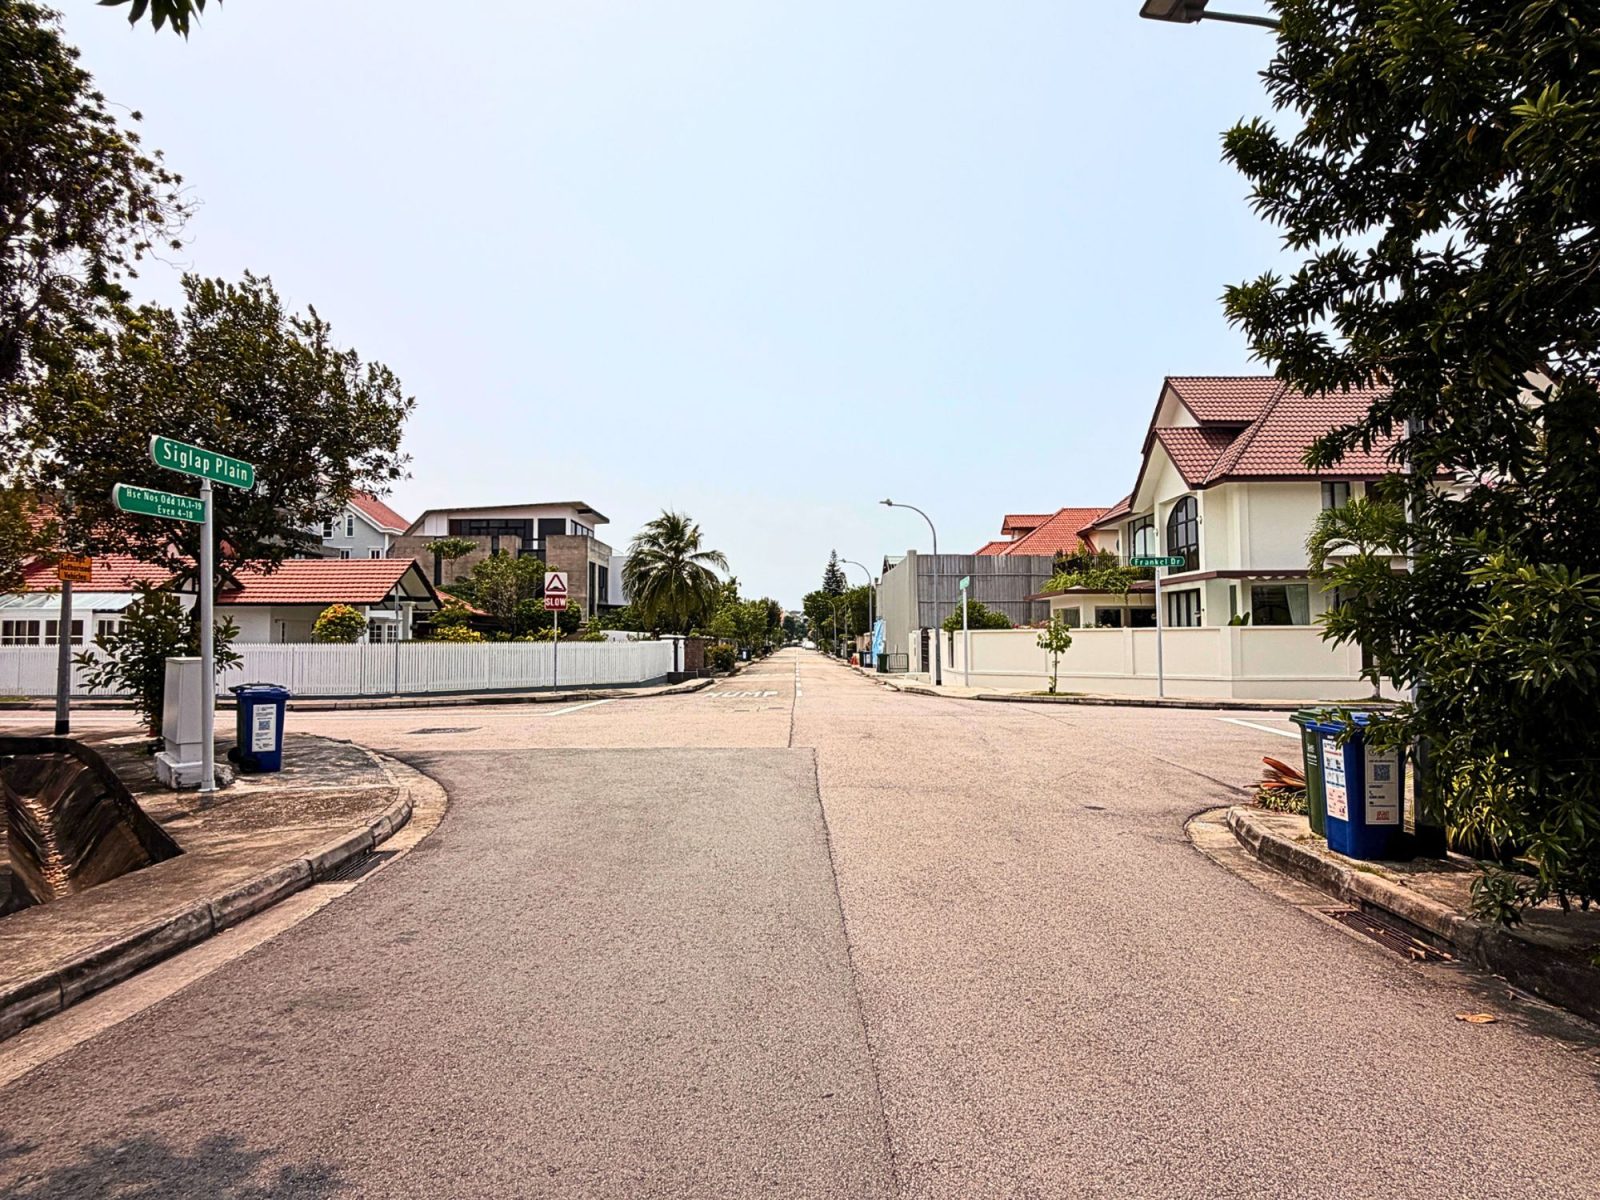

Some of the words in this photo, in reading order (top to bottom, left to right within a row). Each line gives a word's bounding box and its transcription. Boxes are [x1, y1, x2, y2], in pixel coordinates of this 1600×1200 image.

[163, 442, 210, 474] Siglap
[215, 457, 247, 481] Plain
[126, 488, 141, 500] Hse
[143, 491, 159, 502] Nos
[160, 494, 176, 505] Odd
[157, 504, 175, 516] Even
[177, 509, 193, 519] 4-18
[1170, 557, 1181, 566] Dr
[545, 597, 566, 607] SLOW
[704, 690, 778, 698] HUMP
